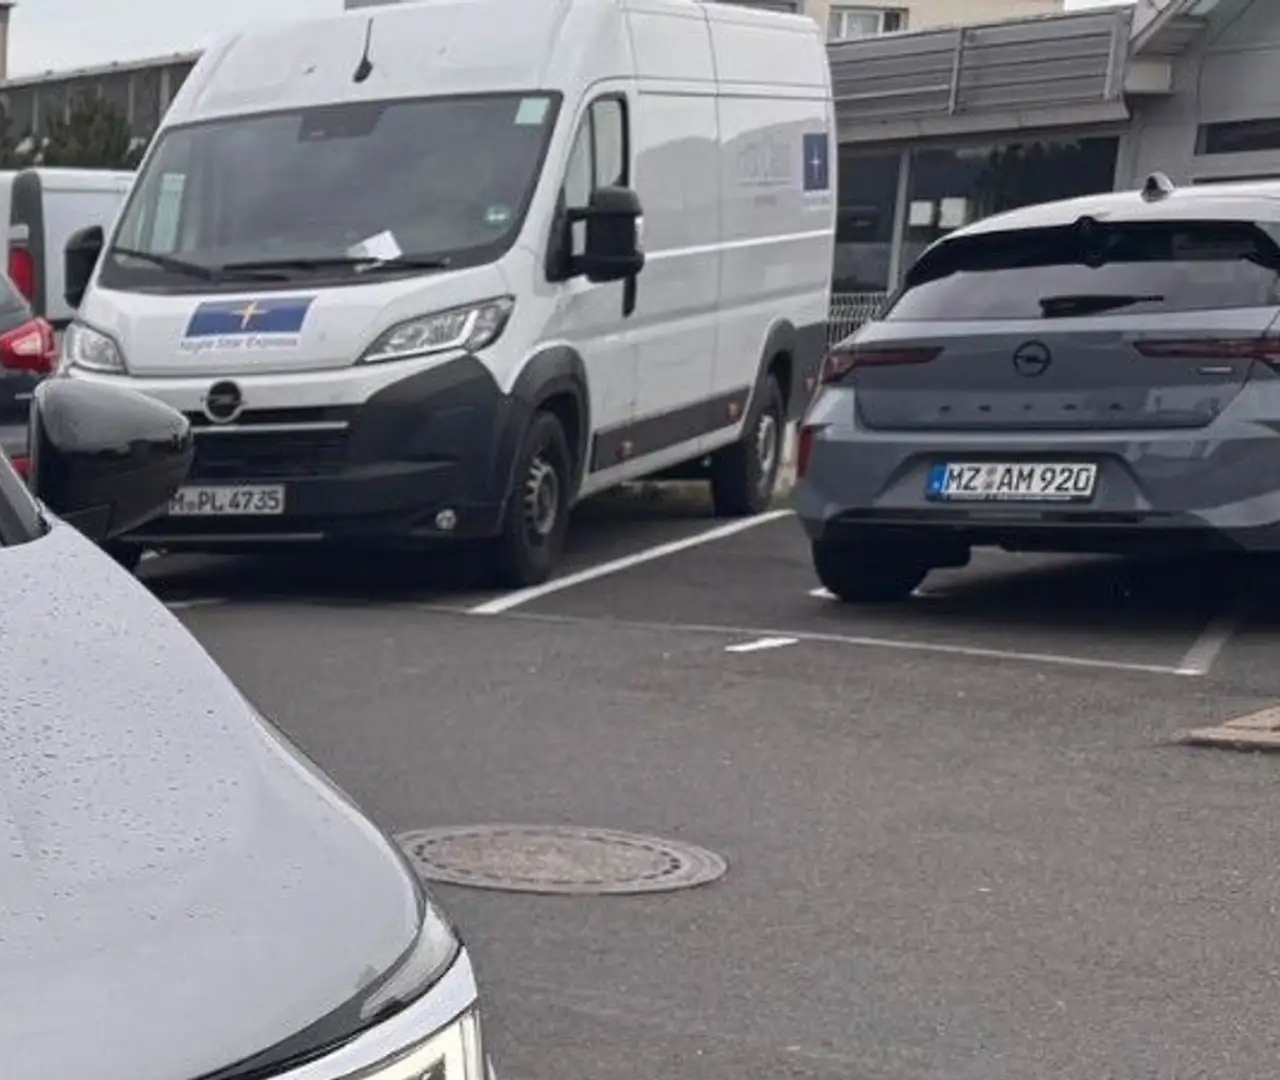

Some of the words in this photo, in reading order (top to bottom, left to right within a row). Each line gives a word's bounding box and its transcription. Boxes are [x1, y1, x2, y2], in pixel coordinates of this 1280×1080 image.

[945, 467, 980, 490] MZ
[997, 467, 1035, 491] AM
[1040, 467, 1090, 491] 920
[198, 491, 220, 511] PL
[228, 490, 280, 511] 4735
